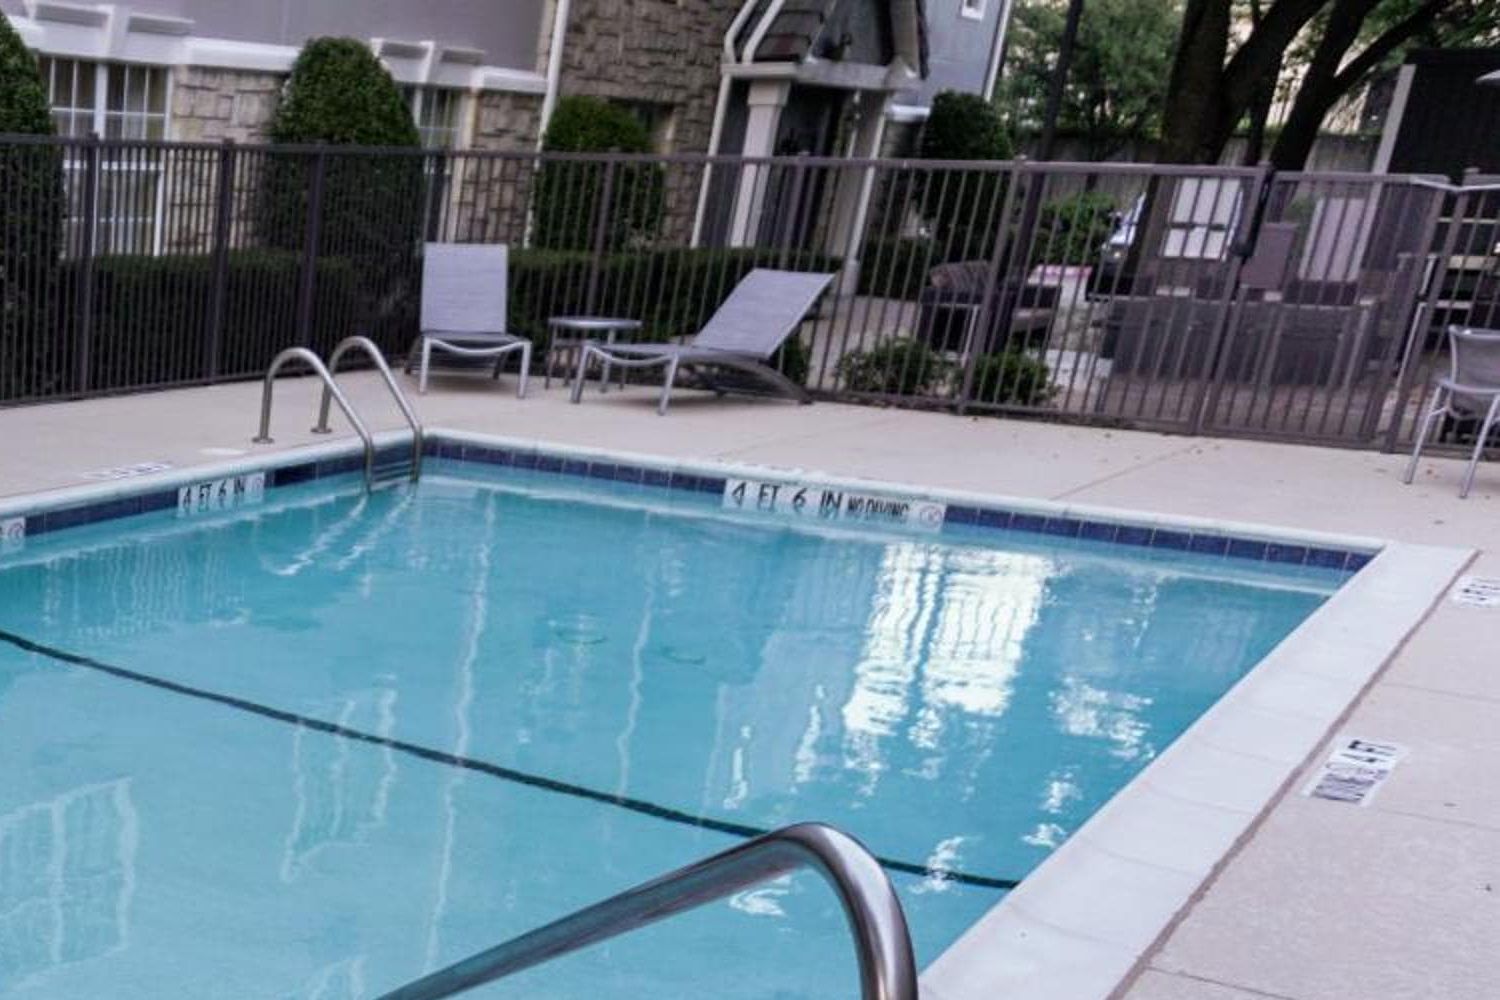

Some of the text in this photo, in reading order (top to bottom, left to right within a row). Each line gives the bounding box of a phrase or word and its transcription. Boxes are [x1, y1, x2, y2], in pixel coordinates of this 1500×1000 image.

[731, 482, 746, 501] 4
[757, 483, 781, 502] FT
[793, 487, 808, 506] 6
[819, 489, 844, 510] IN
